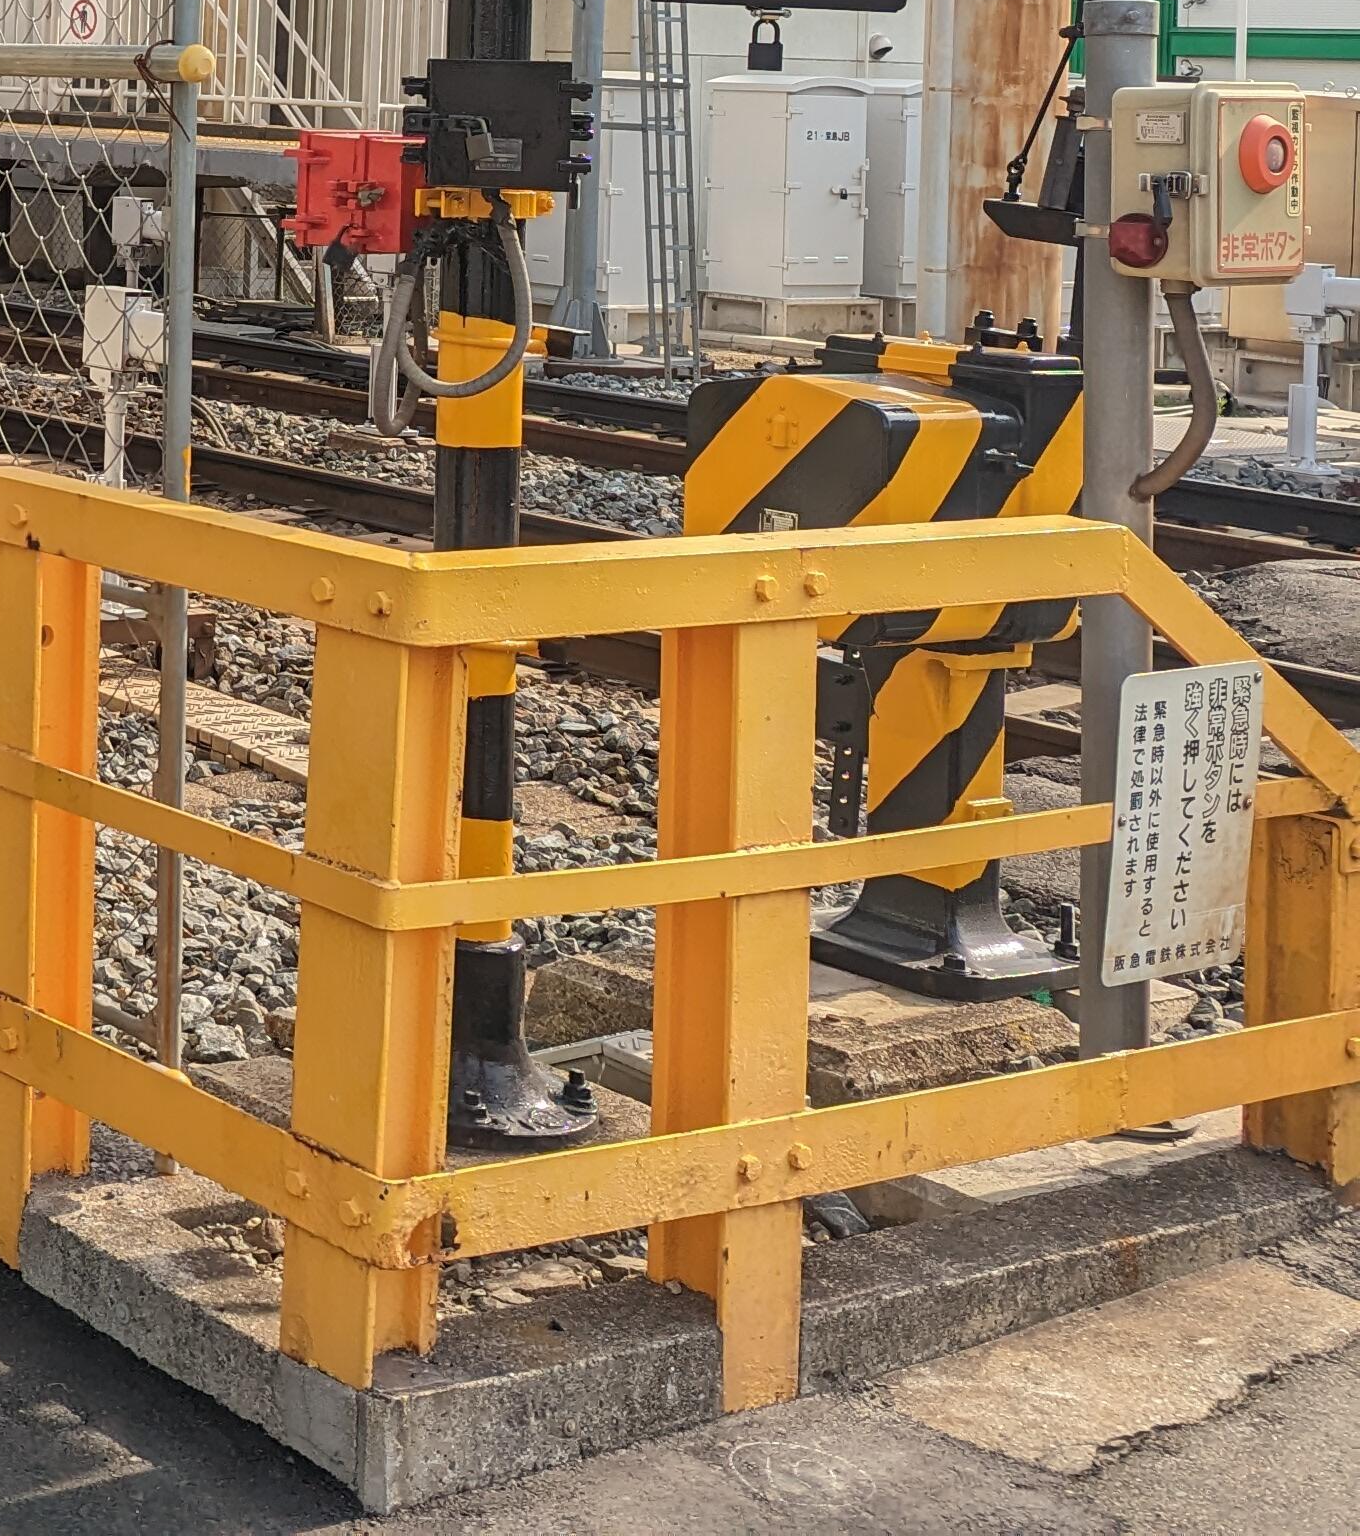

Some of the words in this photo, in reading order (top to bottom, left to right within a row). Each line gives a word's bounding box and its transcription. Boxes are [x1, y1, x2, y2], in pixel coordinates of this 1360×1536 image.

[1222, 231, 1301, 262] 非常ボタン
[1123, 703, 1148, 899] 法律で処罰されます
[1138, 699, 1168, 938] 緊急時以外に使用すると
[1170, 680, 1205, 931] 強く押してください
[1200, 677, 1229, 844] 非常ボタンを
[1227, 675, 1252, 814] 緊急時には
[1112, 937, 1232, 973] 阪急電鉄株式会社
